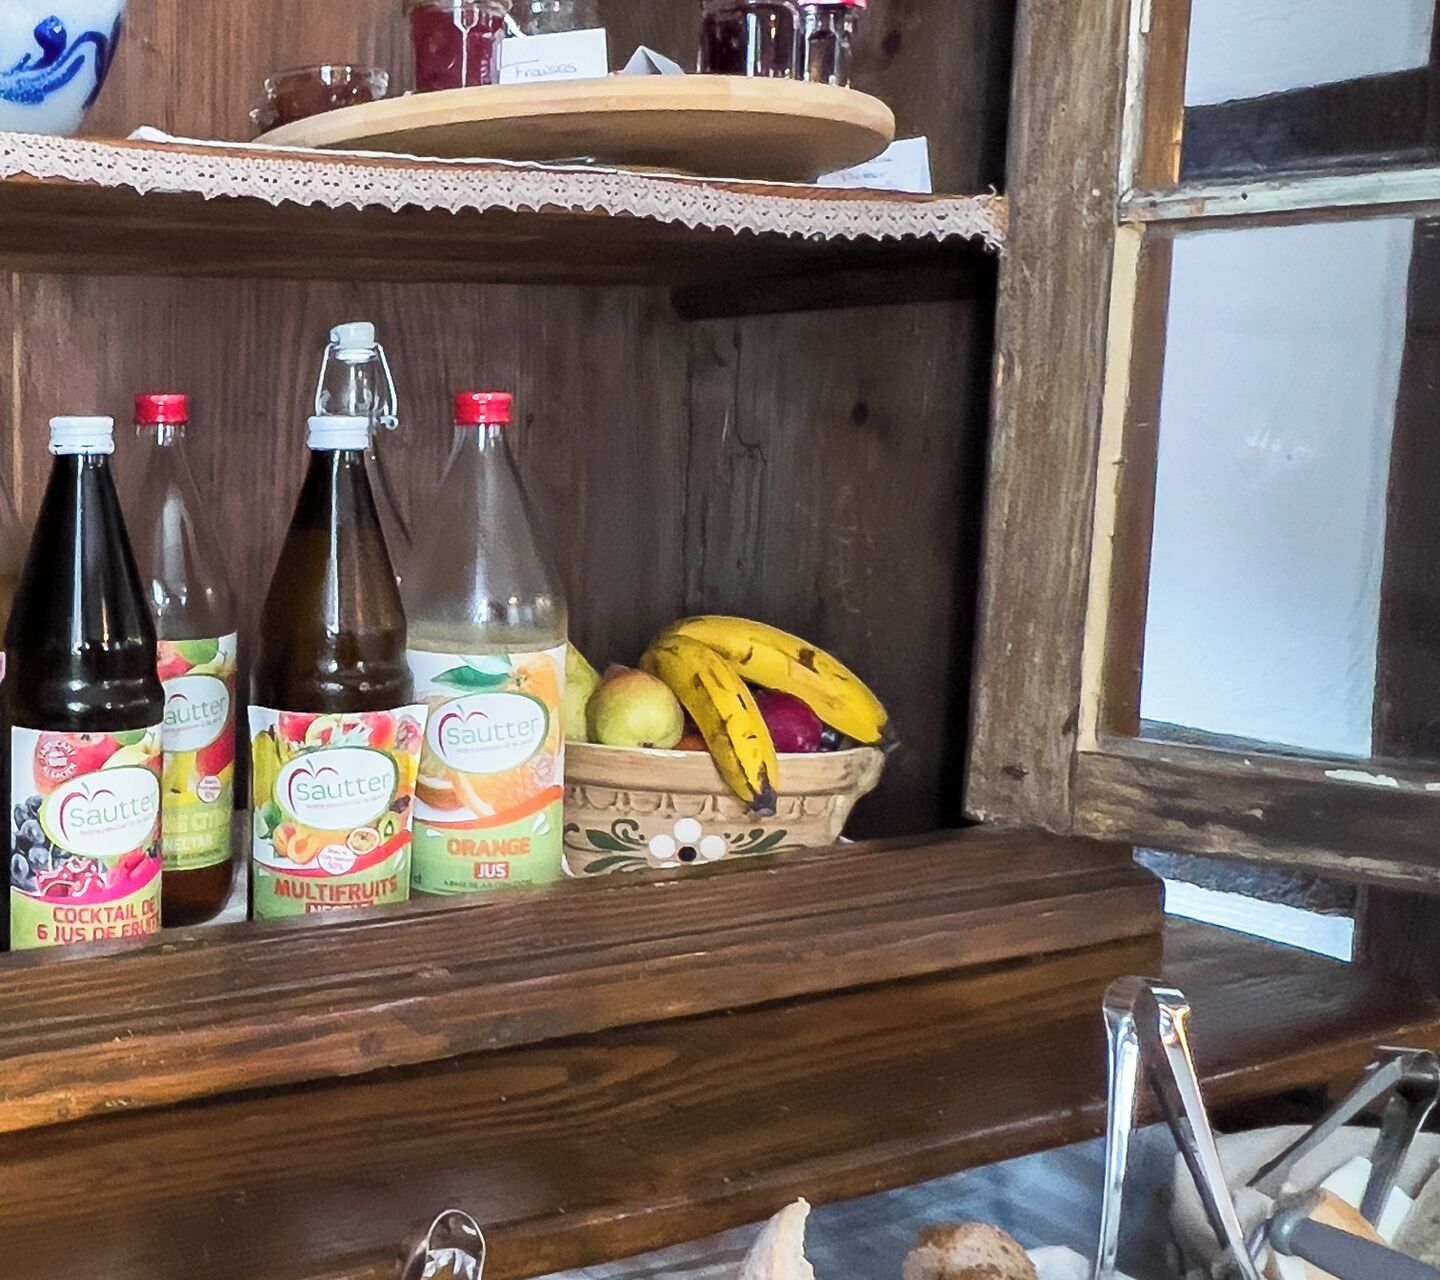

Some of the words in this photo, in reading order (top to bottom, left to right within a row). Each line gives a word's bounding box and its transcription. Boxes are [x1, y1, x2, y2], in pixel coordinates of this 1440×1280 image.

[163, 696, 227, 725] autter
[447, 837, 531, 856] ORANGE
[479, 863, 506, 878] JUS
[274, 875, 397, 901] MULTIFRUITS
[52, 903, 136, 925] COCKTAIL
[37, 924, 48, 940] 6
[54, 926, 86, 943] JUS
